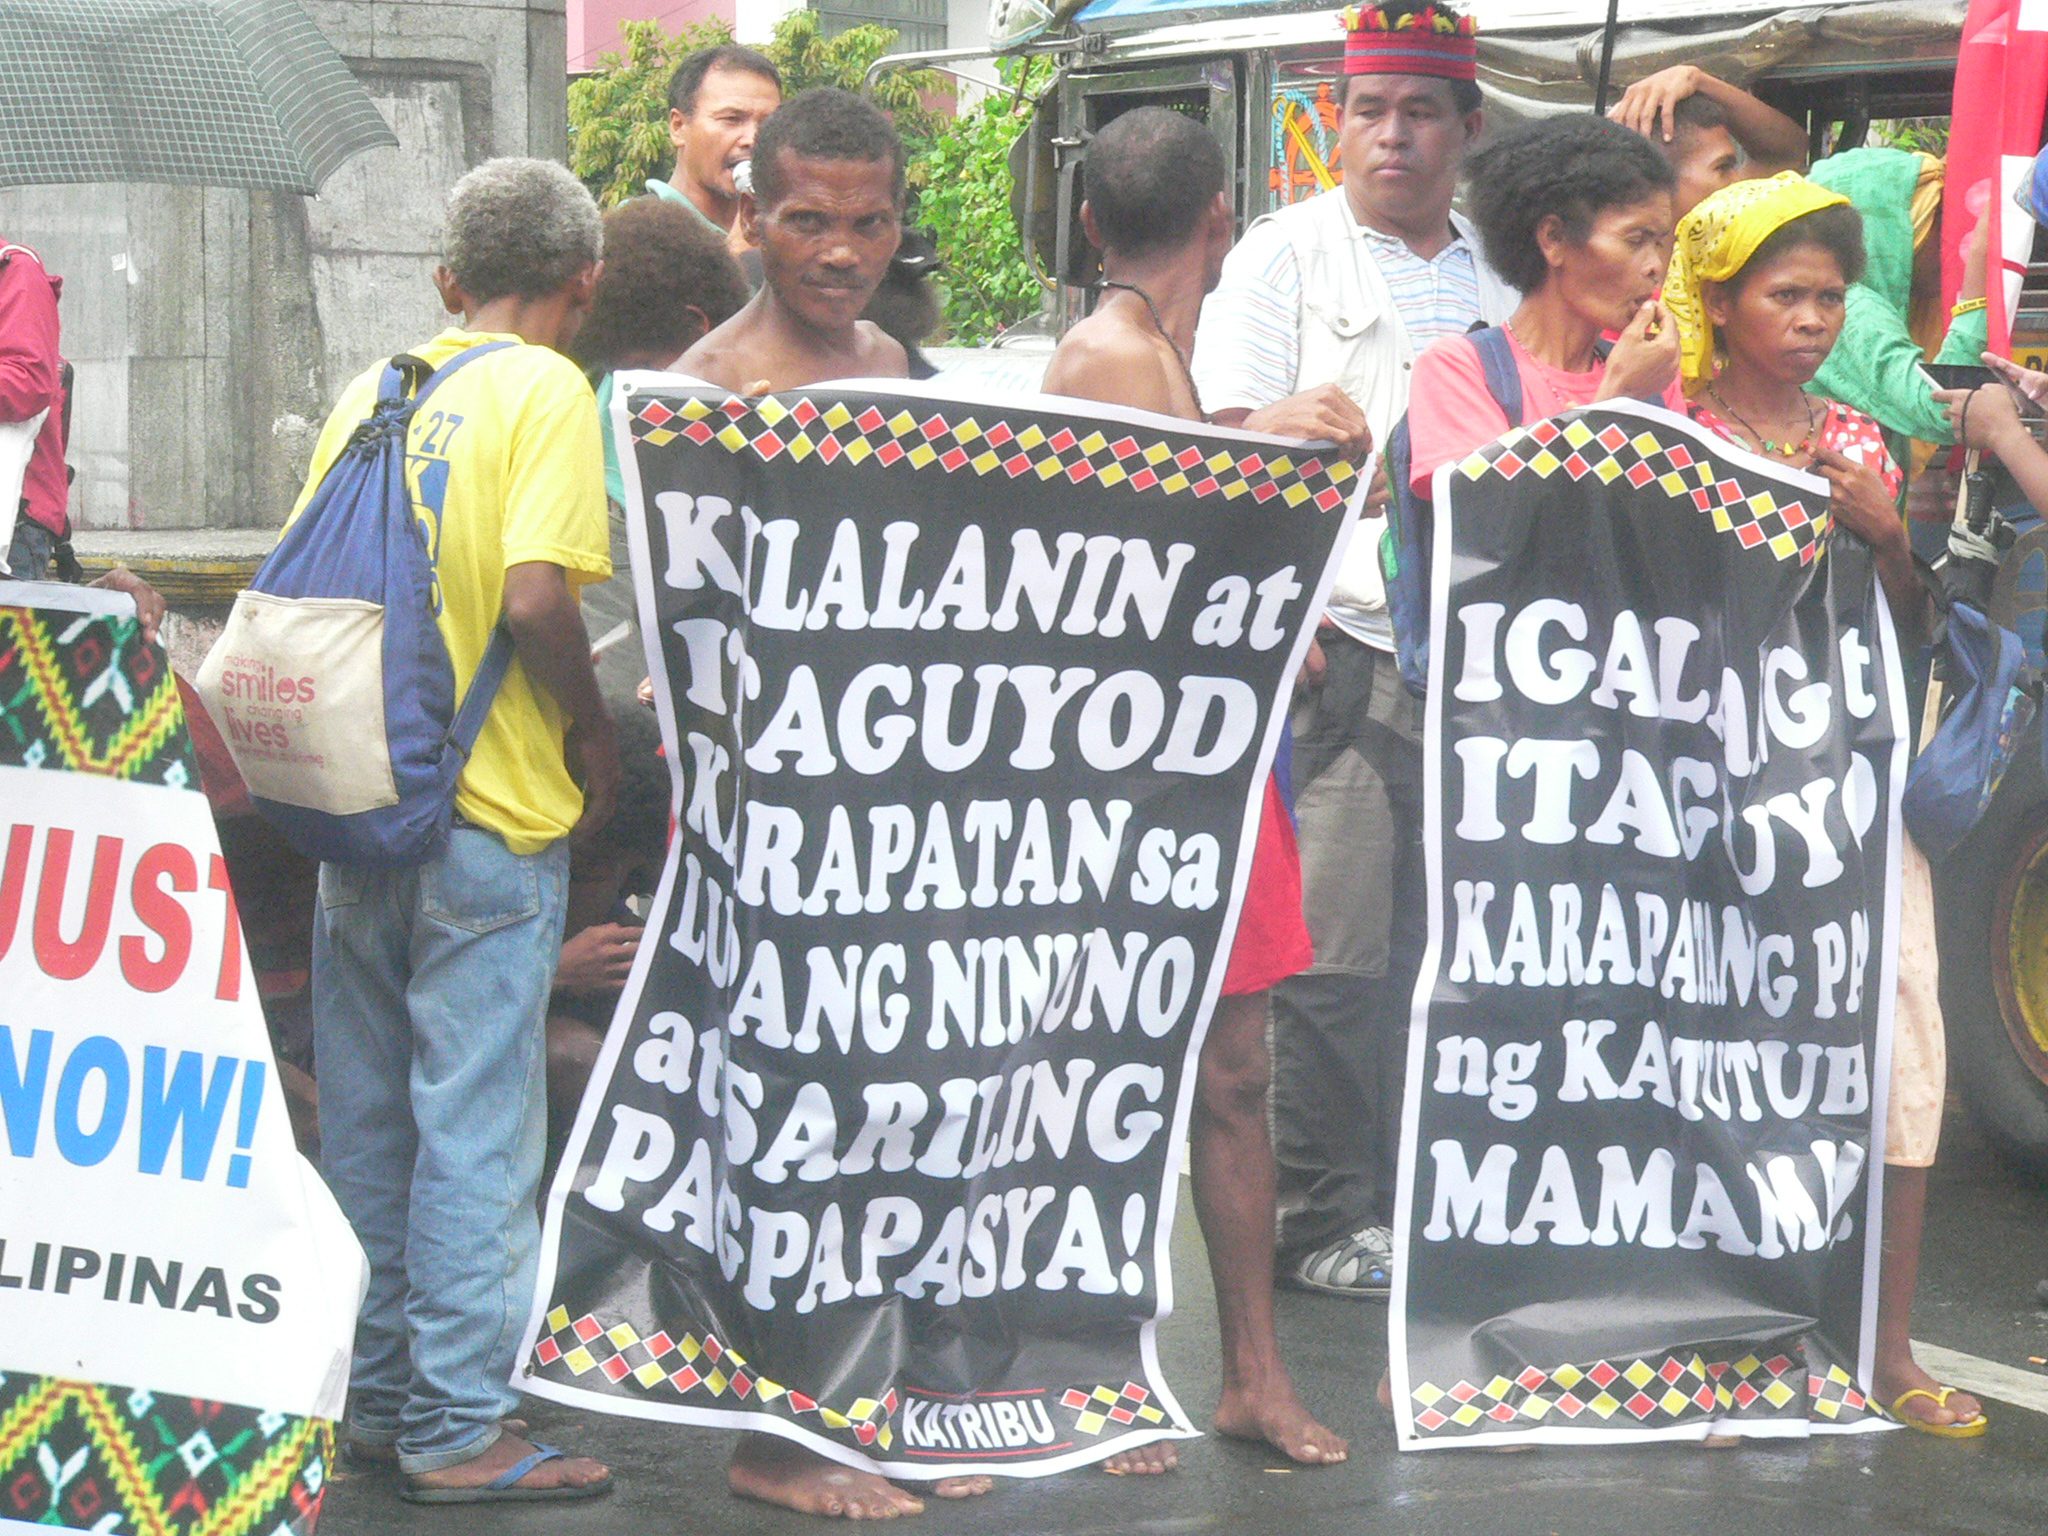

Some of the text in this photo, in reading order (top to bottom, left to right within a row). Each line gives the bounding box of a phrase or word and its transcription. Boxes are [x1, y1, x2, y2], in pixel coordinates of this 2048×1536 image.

[222, 666, 316, 704] smiles
[1193, 565, 1303, 652] at
[1453, 598, 1832, 777] IGALAG
[223, 705, 290, 749] lives
[686, 731, 1222, 917] KRAPATAN sa
[669, 853, 911, 1055] LUANG
[0, 1024, 266, 1189] NOW!
[634, 1010, 1165, 1184] at SARILING
[1433, 1035, 1542, 1121] ng
[584, 1103, 1147, 1314] PAGPAPASYA!
[902, 1397, 1056, 1449] KATRIBU
